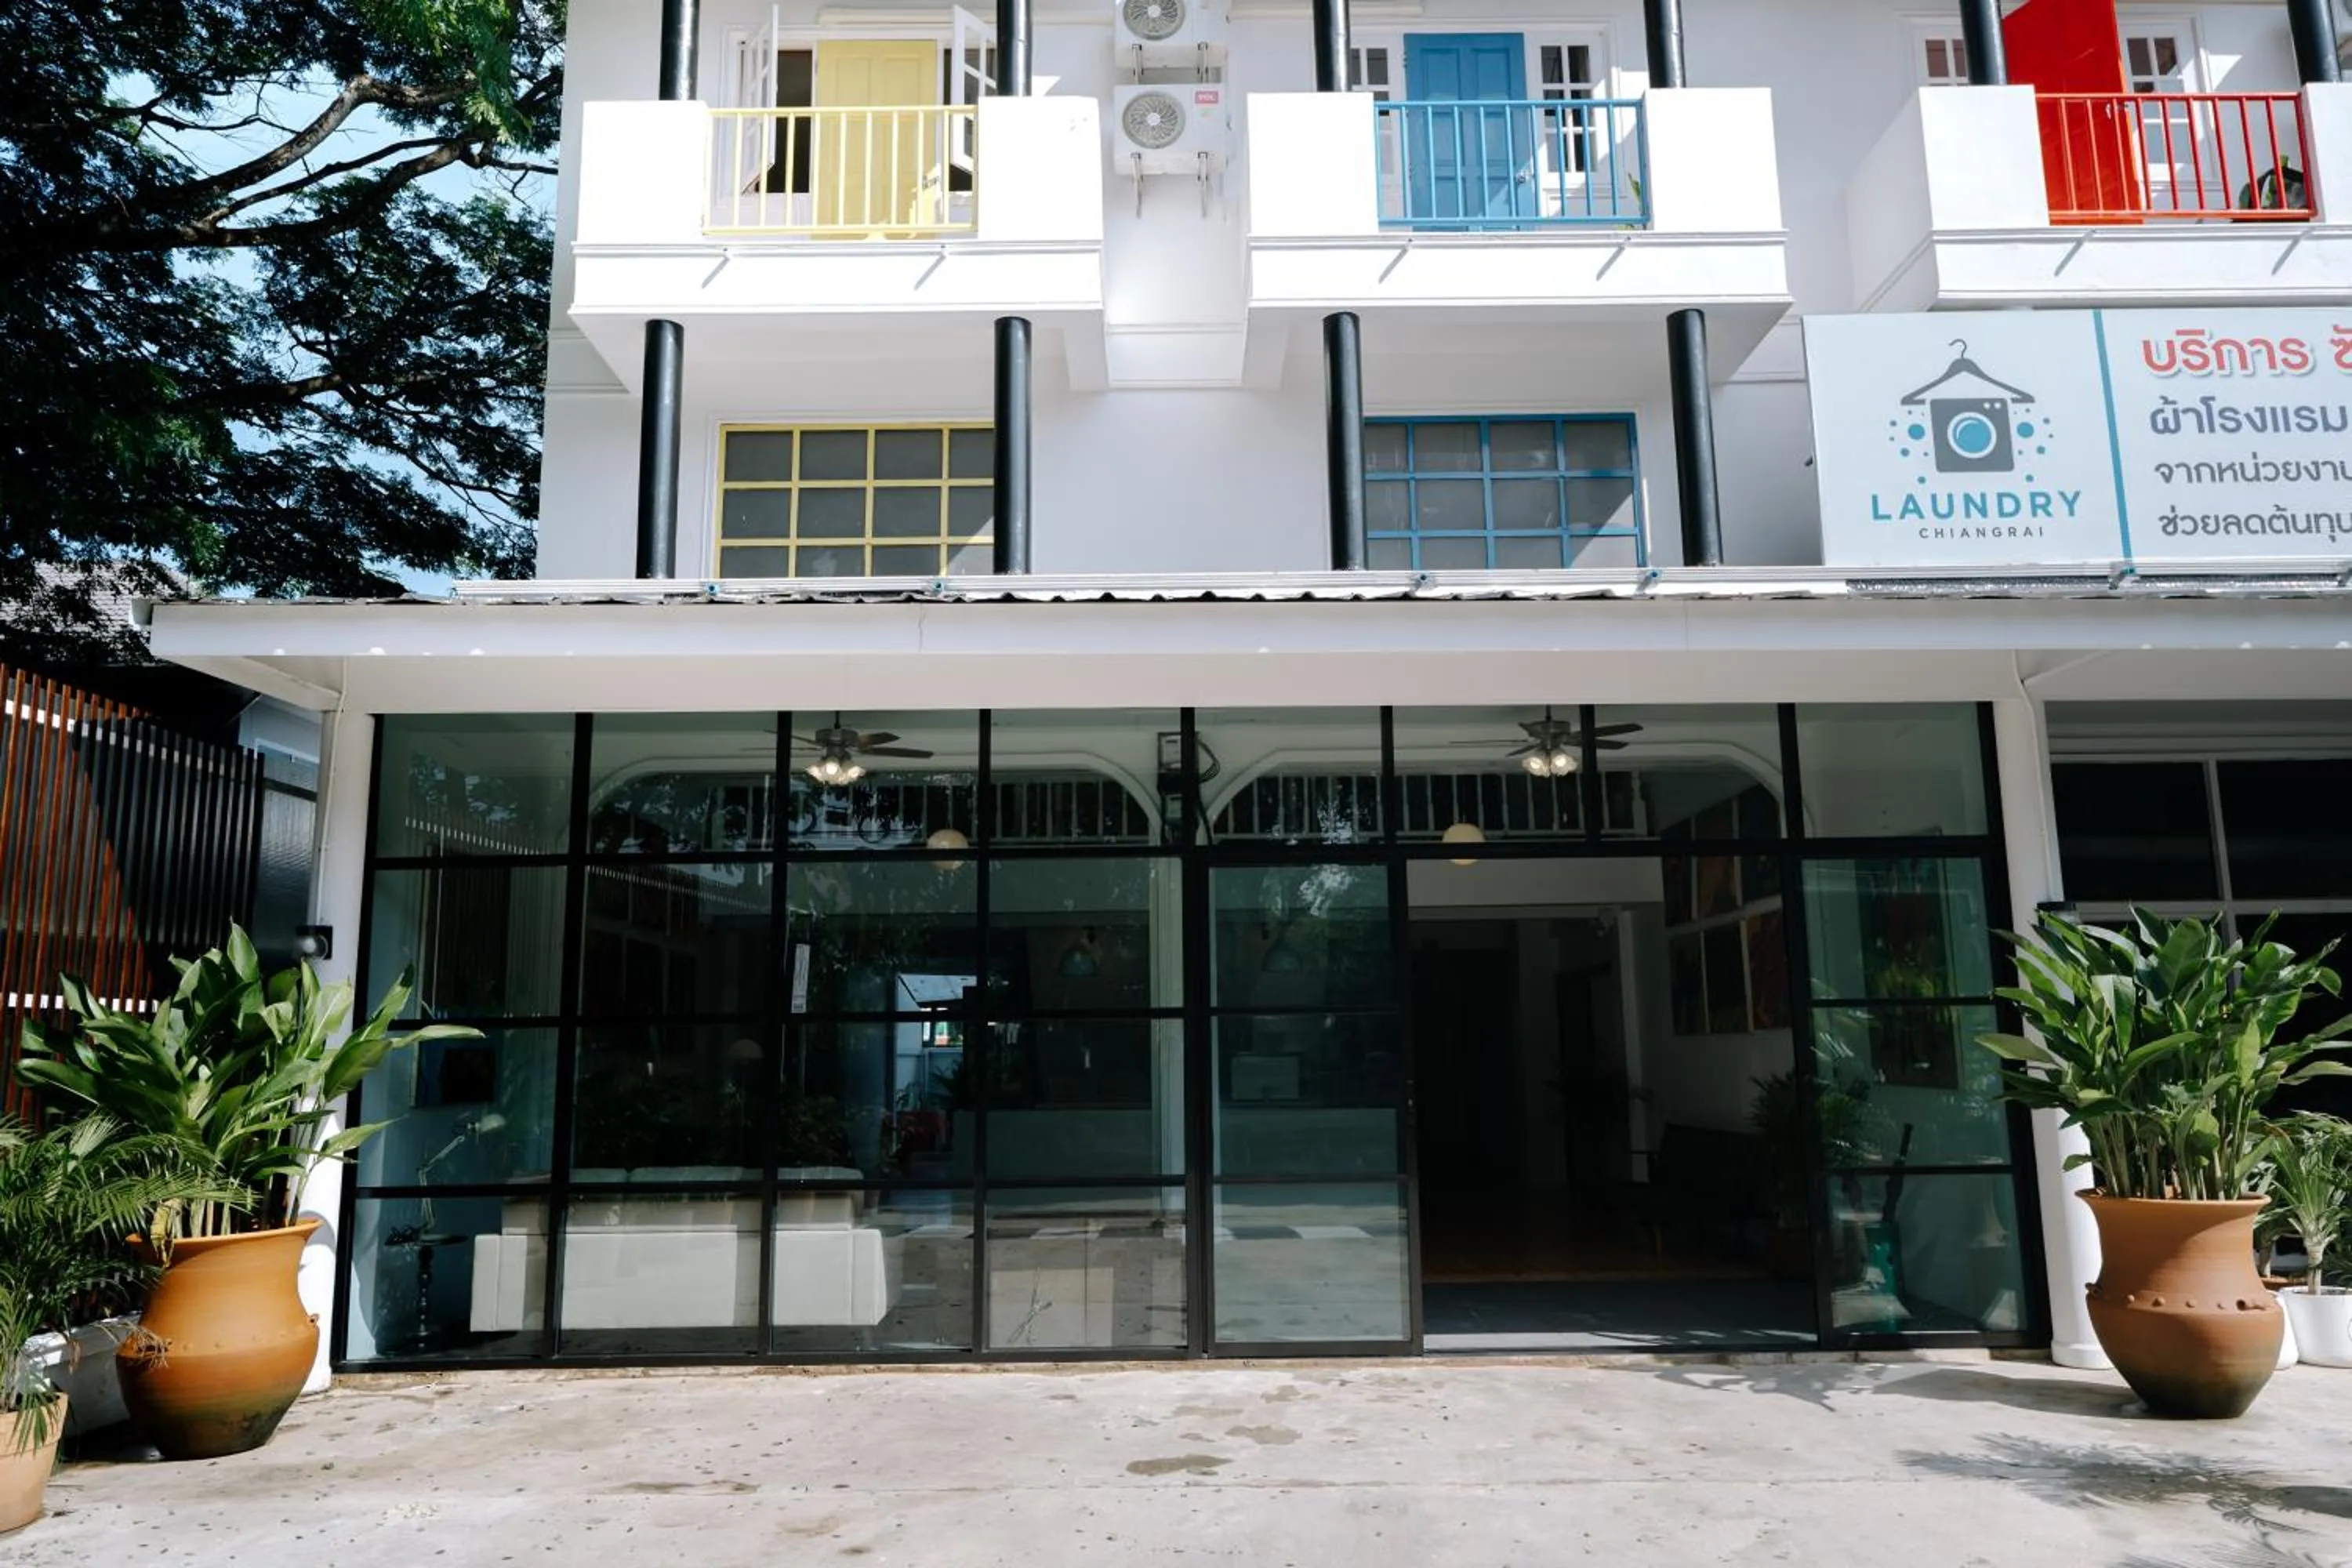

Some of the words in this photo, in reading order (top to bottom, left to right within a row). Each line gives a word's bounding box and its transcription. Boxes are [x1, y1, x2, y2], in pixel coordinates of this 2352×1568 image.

[2142, 328, 2310, 374] บริการ
[2149, 394, 2349, 435] ผ้าโรงแรม
[1871, 489, 2082, 521] LAUNDRY
[1918, 525, 2044, 539] CHIANGRAI
